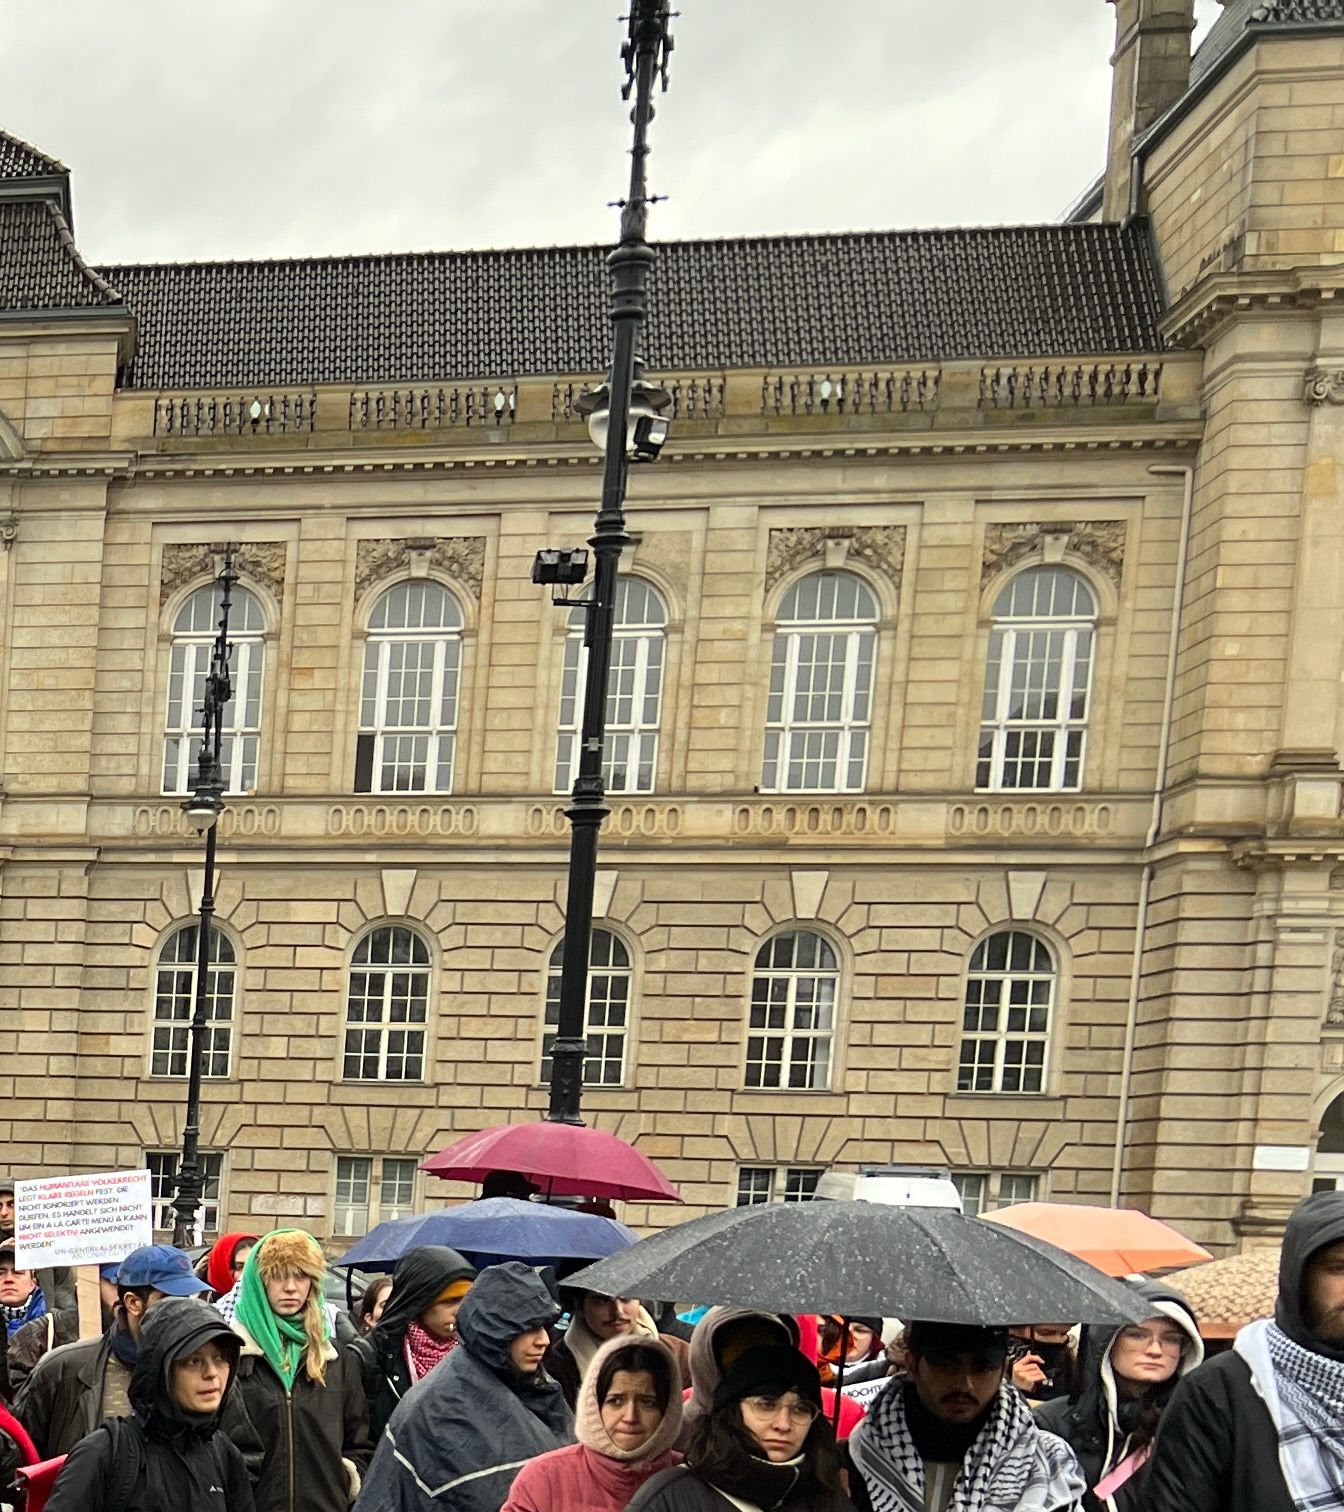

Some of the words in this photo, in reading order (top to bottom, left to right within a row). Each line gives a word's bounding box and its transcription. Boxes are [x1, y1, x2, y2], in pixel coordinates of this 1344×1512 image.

[19, 1194, 36, 1203] LEGT
[37, 1192, 62, 1201] KLARE
[64, 1189, 94, 1198] REGELN
[19, 1203, 41, 1212] NICHT
[42, 1200, 84, 1211] IGNORIERT
[85, 1196, 119, 1207] WERDEN
[52, 1211, 61, 1219] ES
[63, 1207, 97, 1218] HANDELT
[99, 1205, 118, 1215] SICH
[119, 1203, 143, 1213] NICHT
[19, 1223, 31, 1231] UM
[32, 1222, 45, 1230] EIN
[53, 1220, 64, 1228] LA
[64, 1217, 89, 1227] CARTE
[123, 1213, 148, 1222] KANN
[19, 1231, 41, 1241] NICHT
[44, 1229, 78, 1239] SELEKTIV
[79, 1224, 134, 1236] ANGEWENDET
